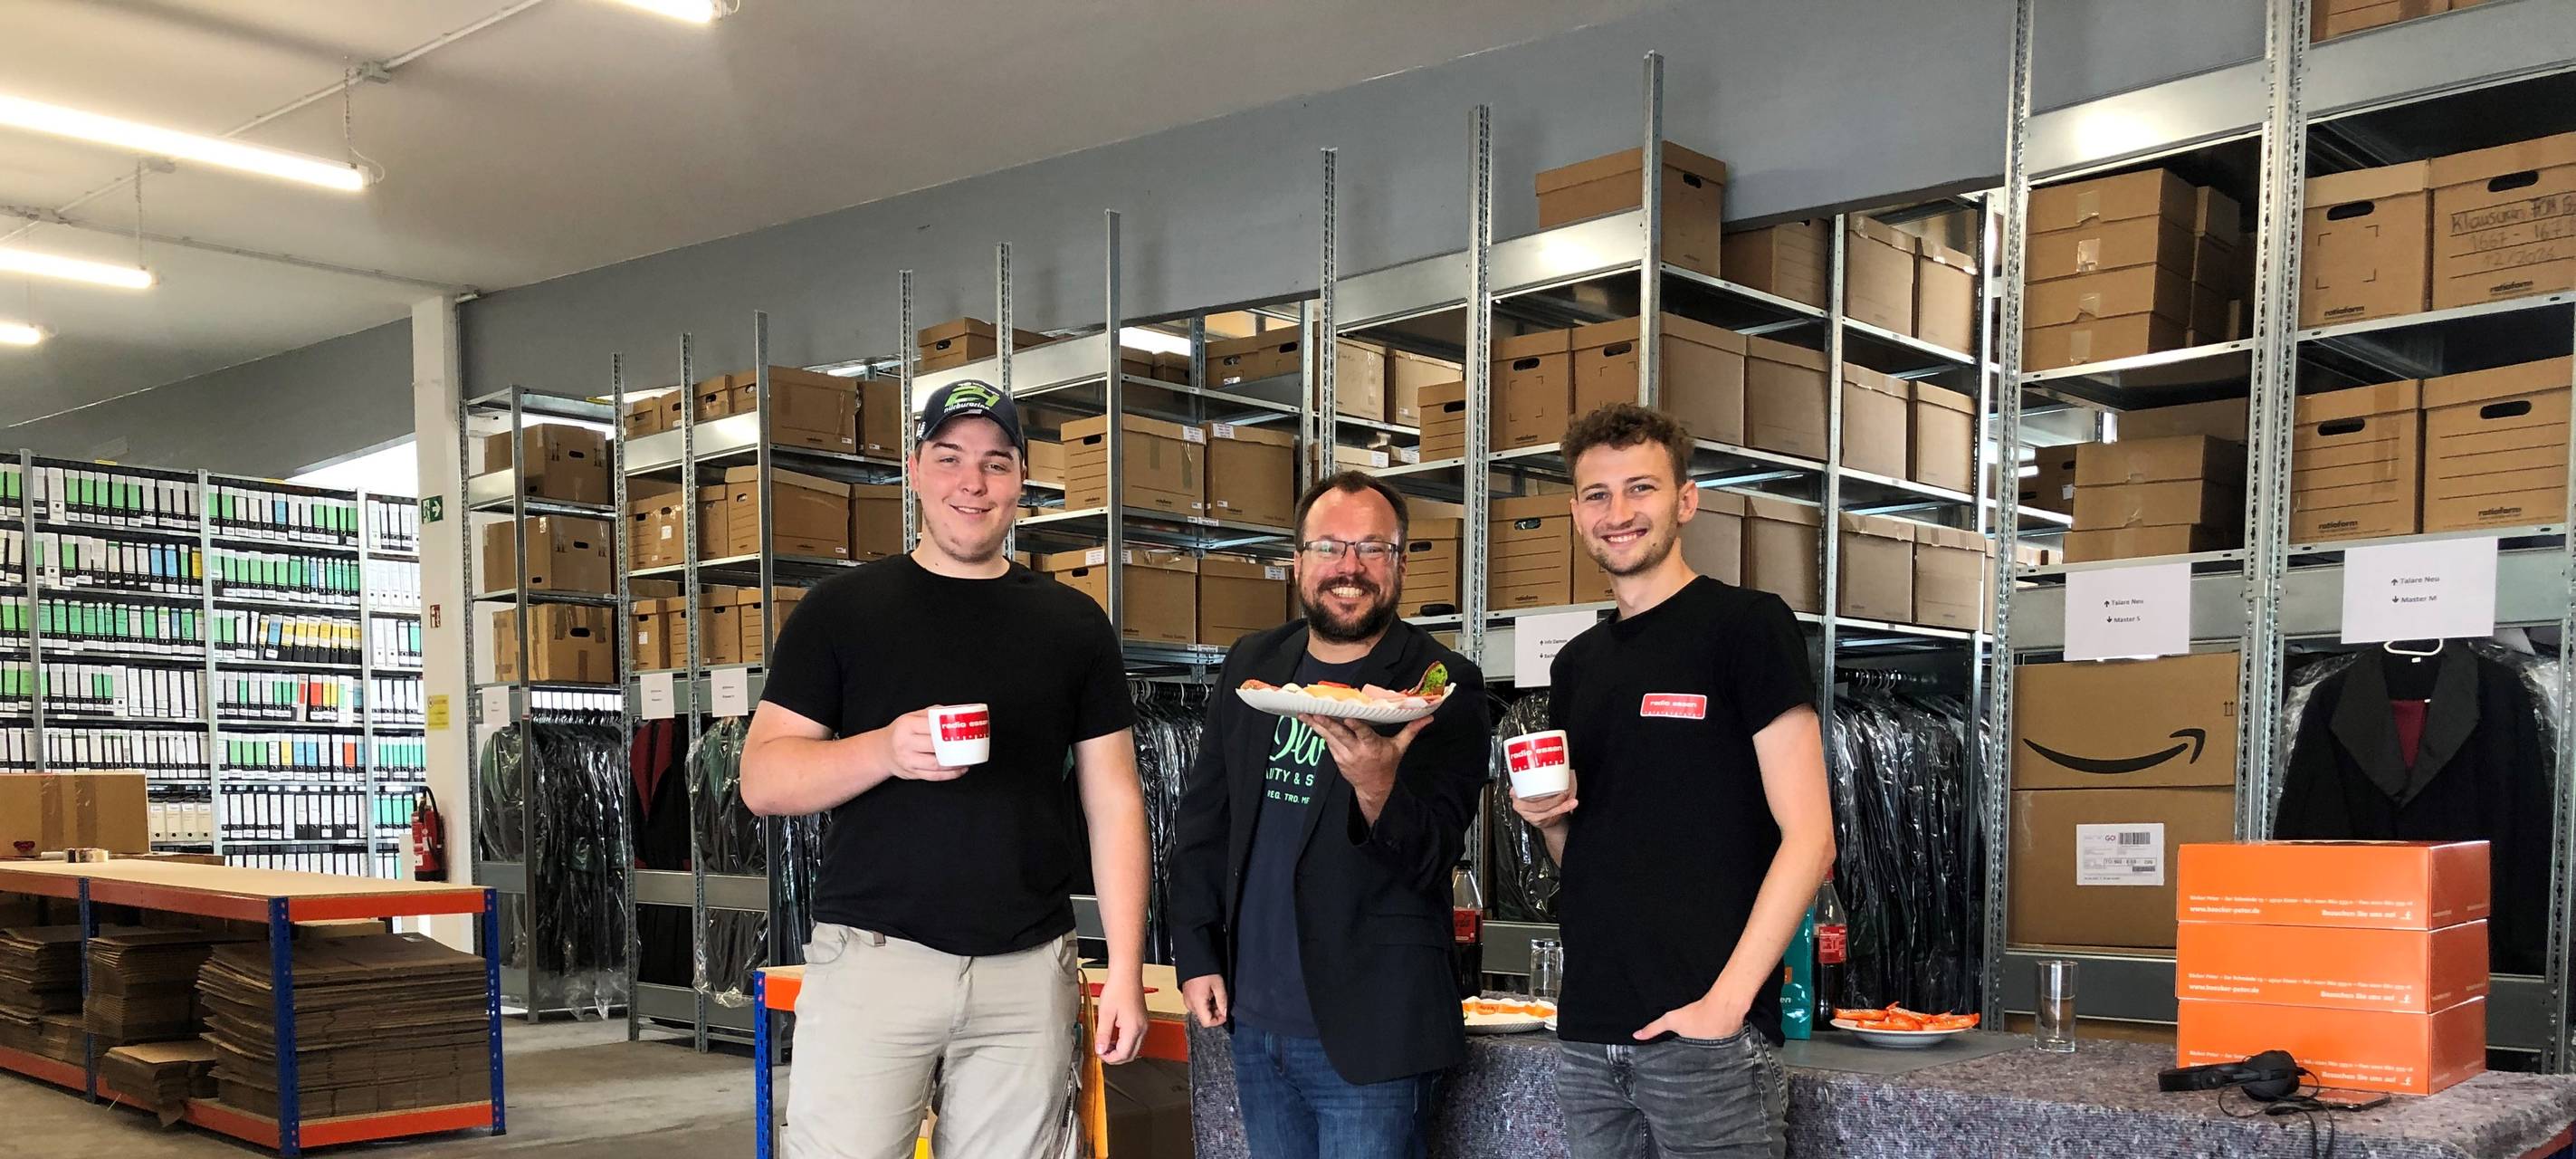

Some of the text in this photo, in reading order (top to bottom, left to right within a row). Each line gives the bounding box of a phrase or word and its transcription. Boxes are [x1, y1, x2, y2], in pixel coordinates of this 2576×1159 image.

[941, 721, 967, 730] radio
[1510, 745, 1563, 760] radio essen
[1293, 771, 1301, 785] &
